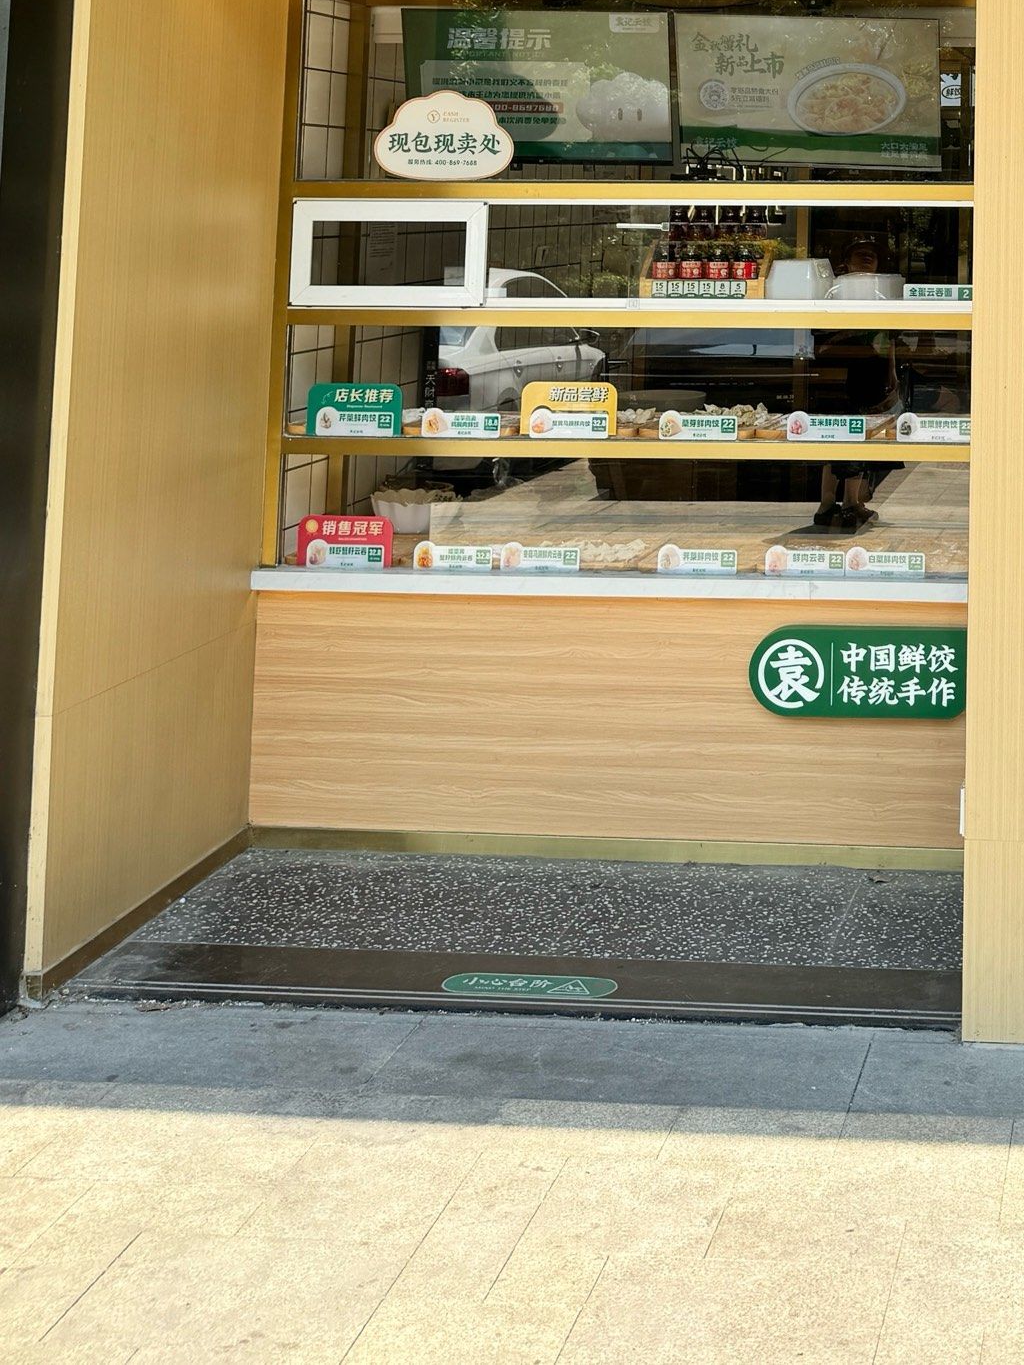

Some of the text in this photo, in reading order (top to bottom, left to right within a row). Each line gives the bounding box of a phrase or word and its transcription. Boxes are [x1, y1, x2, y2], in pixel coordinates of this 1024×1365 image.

[714, 52, 785, 79] 新品上市
[388, 131, 502, 156] 现包现卖处
[334, 388, 394, 404] 店长推荐
[548, 387, 609, 403] 新品尝鲜
[379, 415, 391, 423] 22
[722, 420, 734, 429] 22
[809, 418, 862, 428] 玉米鲜肉饺 22
[322, 520, 384, 536] 销售冠军
[564, 552, 577, 560] 22
[721, 553, 734, 561] 22
[792, 553, 843, 563] 鲜肉云吞 22
[909, 557, 922, 565] 22
[839, 642, 959, 674] 中国鲜饺
[836, 675, 958, 708] 传统手作
